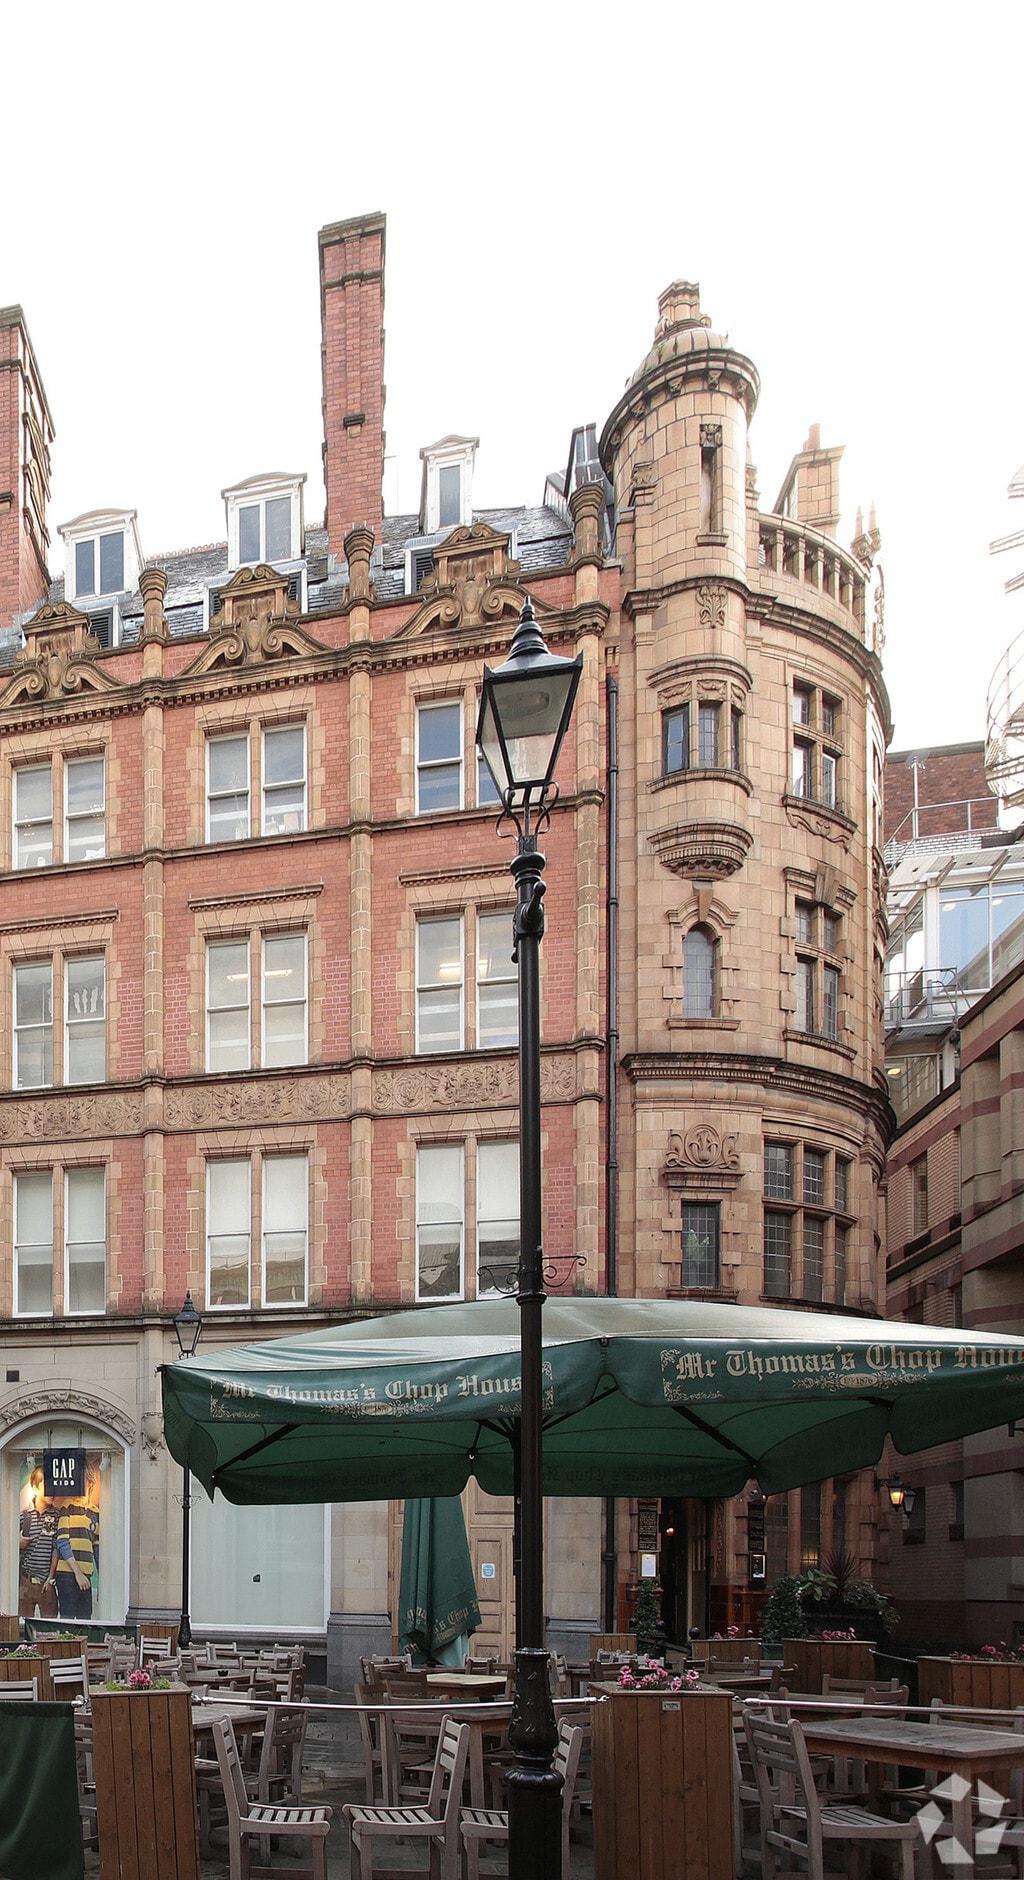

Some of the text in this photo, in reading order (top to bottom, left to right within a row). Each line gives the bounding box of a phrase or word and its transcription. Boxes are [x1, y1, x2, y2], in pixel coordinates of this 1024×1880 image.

[676, 1352, 718, 1380] Mr
[725, 1345, 856, 1381] Thomas's
[866, 1344, 943, 1374] Chop
[222, 1374, 522, 1405] Mr Thomas's Chop Hous
[52, 1458, 75, 1478] GAP
